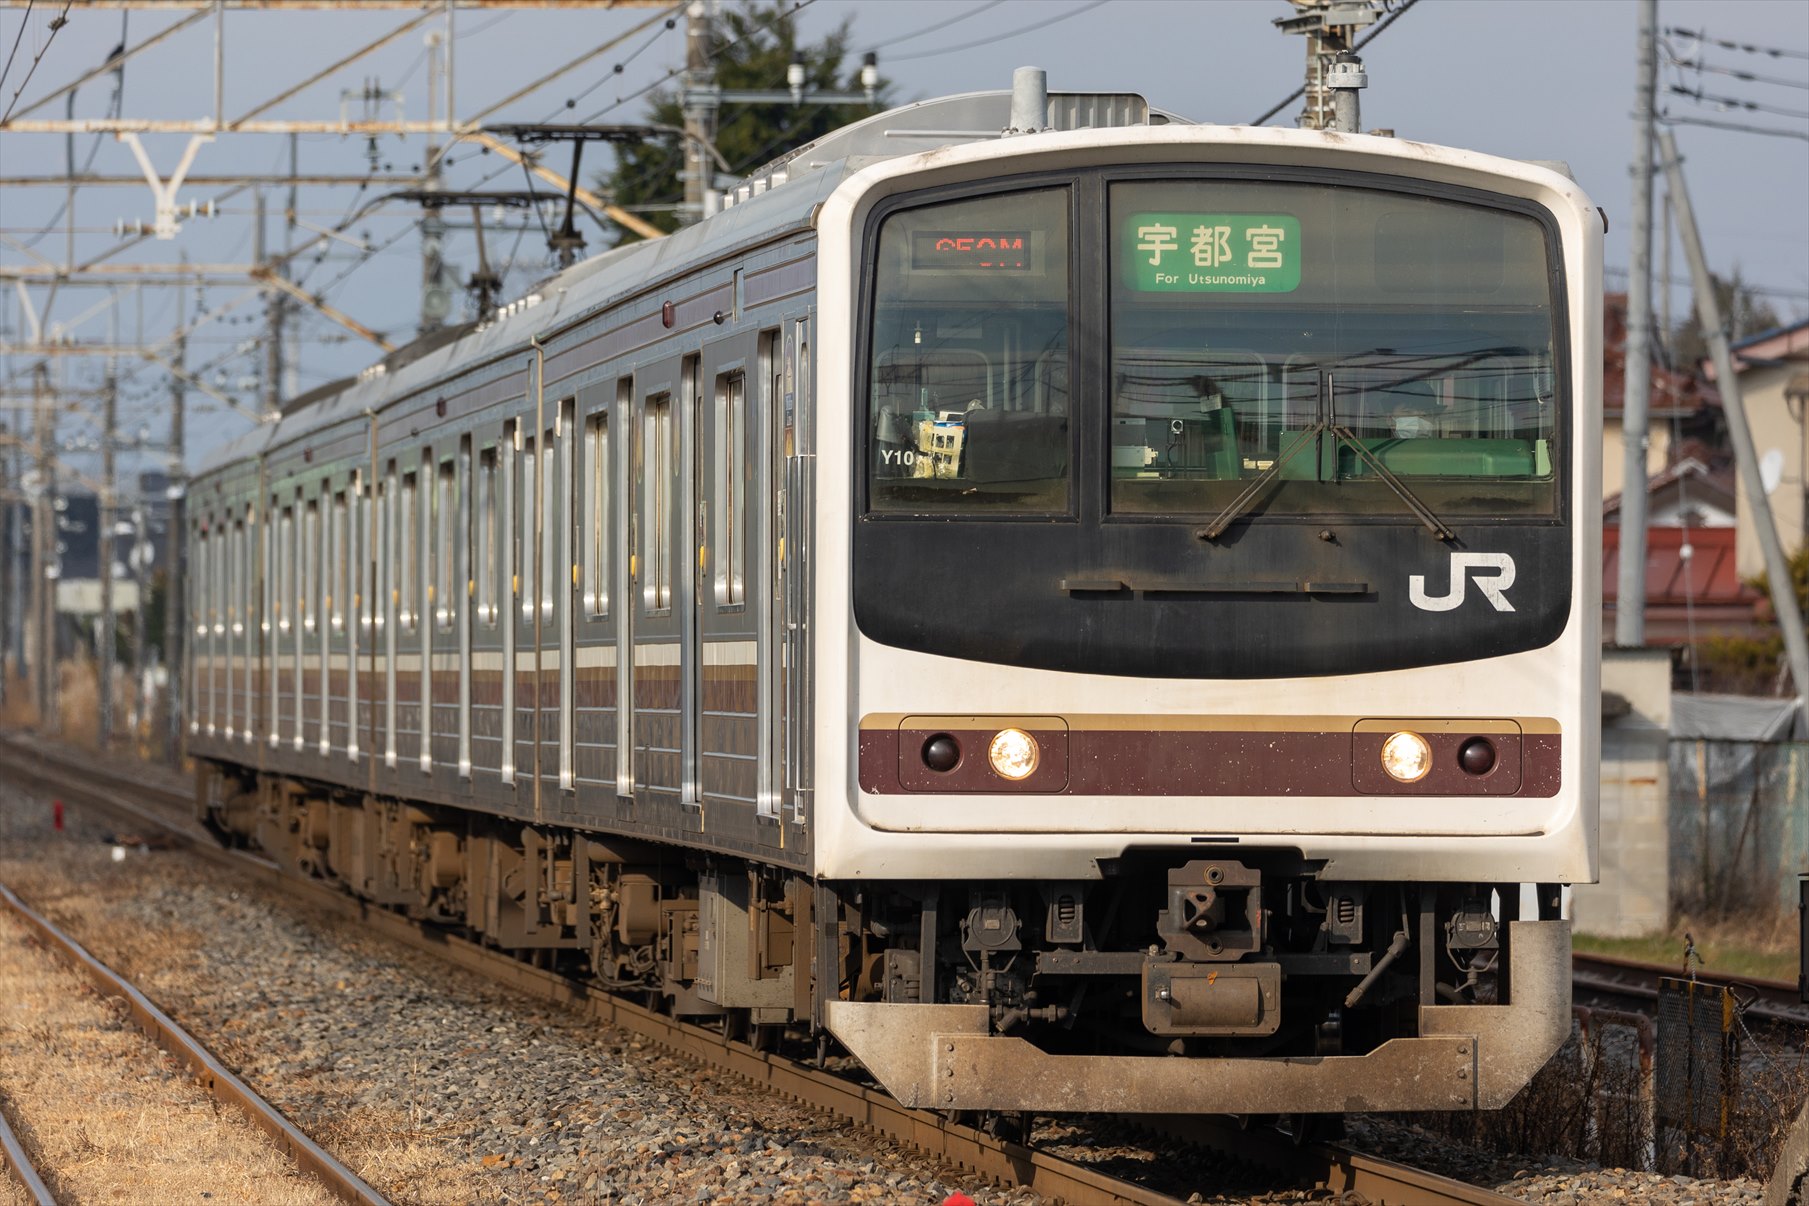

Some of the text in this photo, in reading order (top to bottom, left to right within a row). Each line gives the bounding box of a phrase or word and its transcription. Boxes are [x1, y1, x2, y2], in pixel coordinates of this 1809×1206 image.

[1137, 222, 1285, 268] 宇都宮
[1155, 273, 1266, 287] For Utsunomiya
[881, 449, 914, 466] Y10
[1409, 552, 1516, 612] JR
